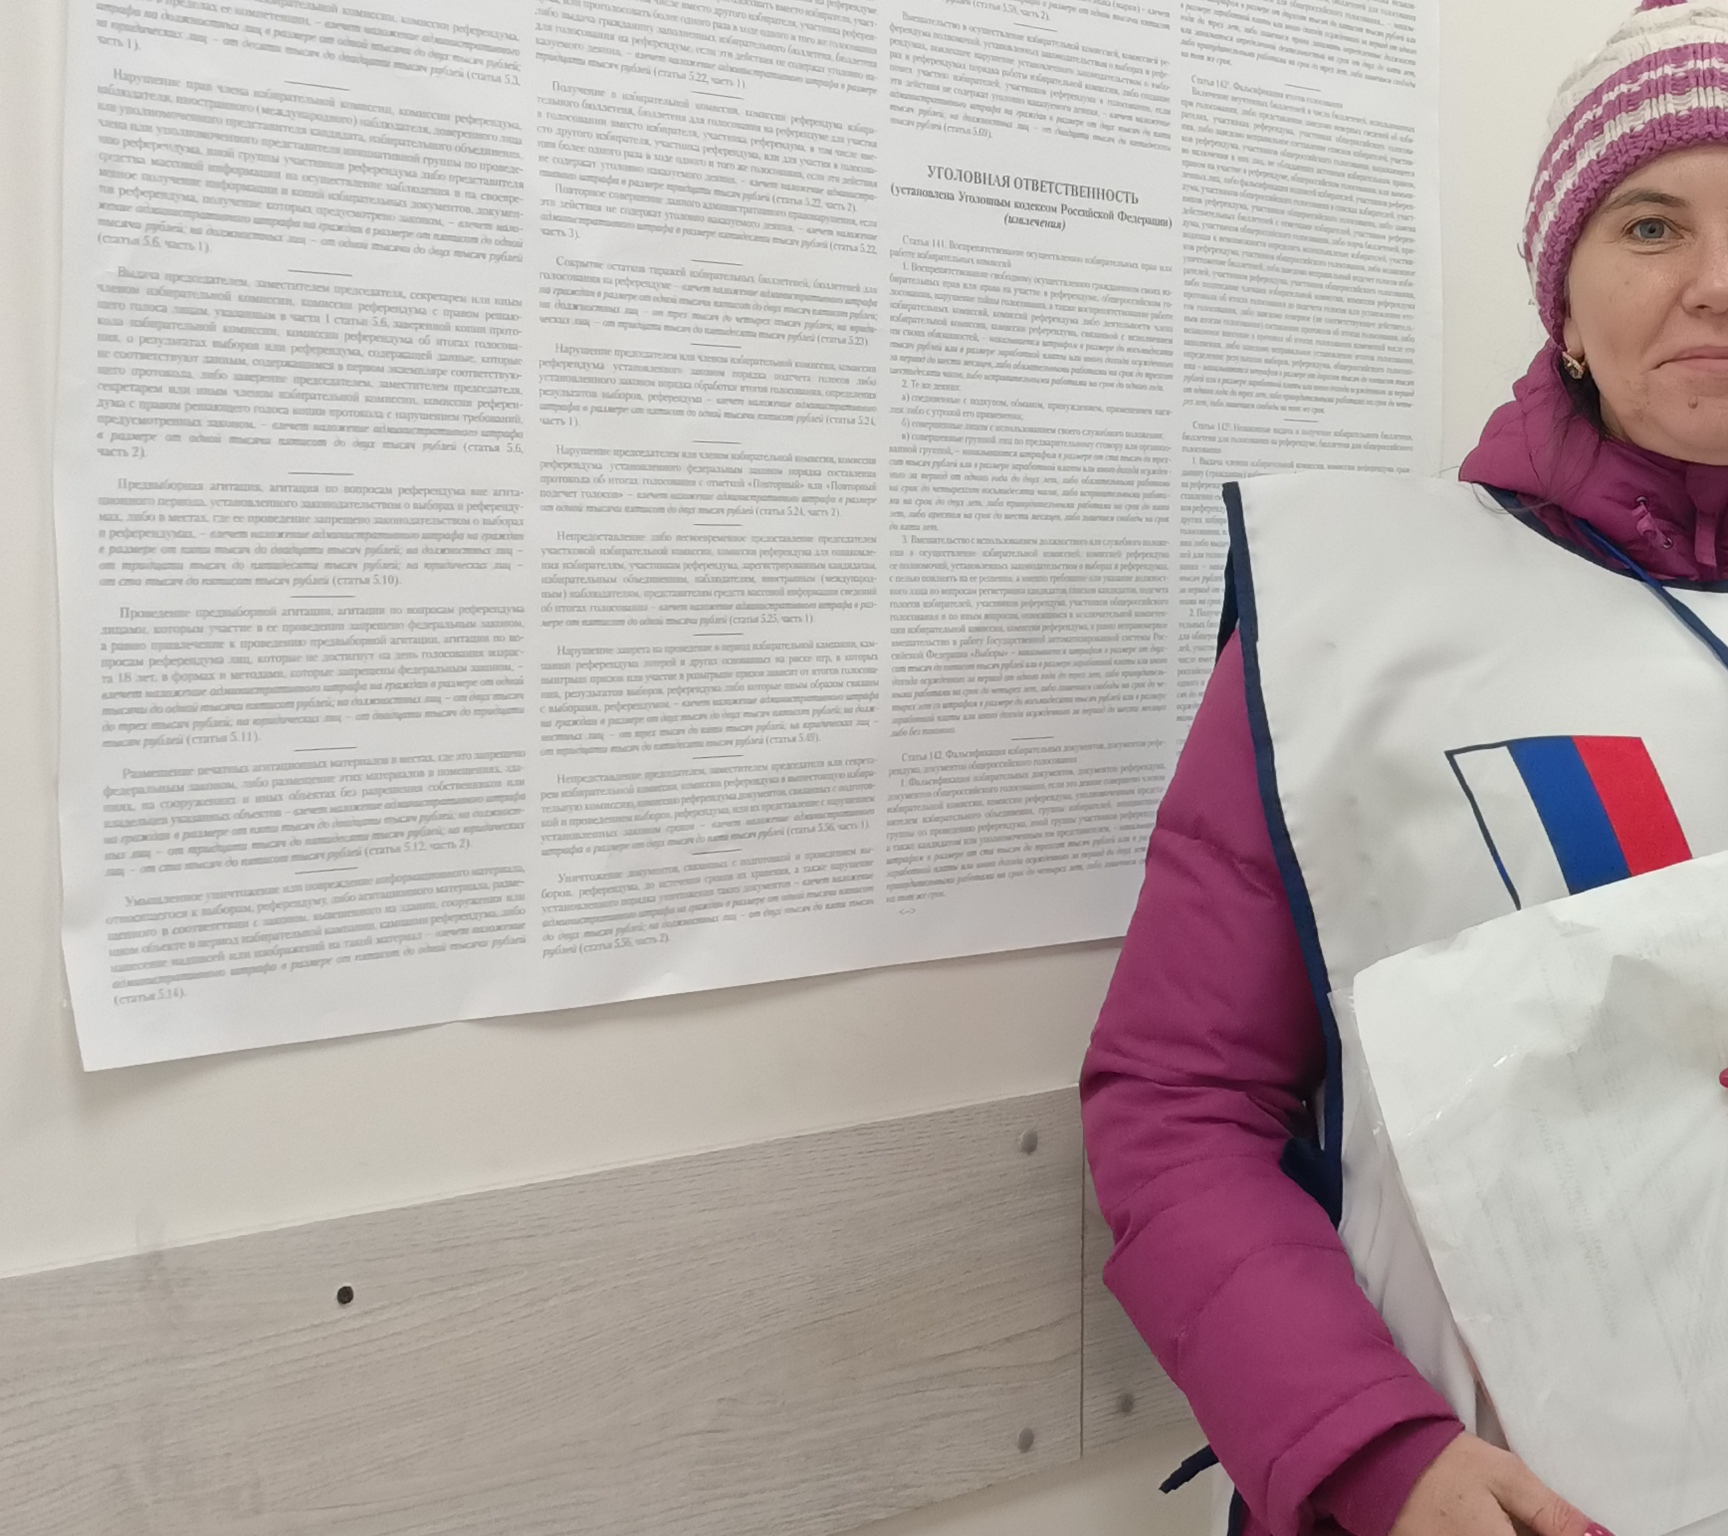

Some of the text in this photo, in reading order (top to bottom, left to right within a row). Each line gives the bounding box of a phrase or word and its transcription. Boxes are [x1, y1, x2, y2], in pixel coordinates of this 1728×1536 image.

[926, 163, 1139, 205] УГОЛОВНАЯ ОТВЕТСТВЕННОСТЬ
[889, 181, 1173, 230] (установлена Уголовным кодексом Российской Федерации)
[1002, 212, 1066, 232] (извлечения)
